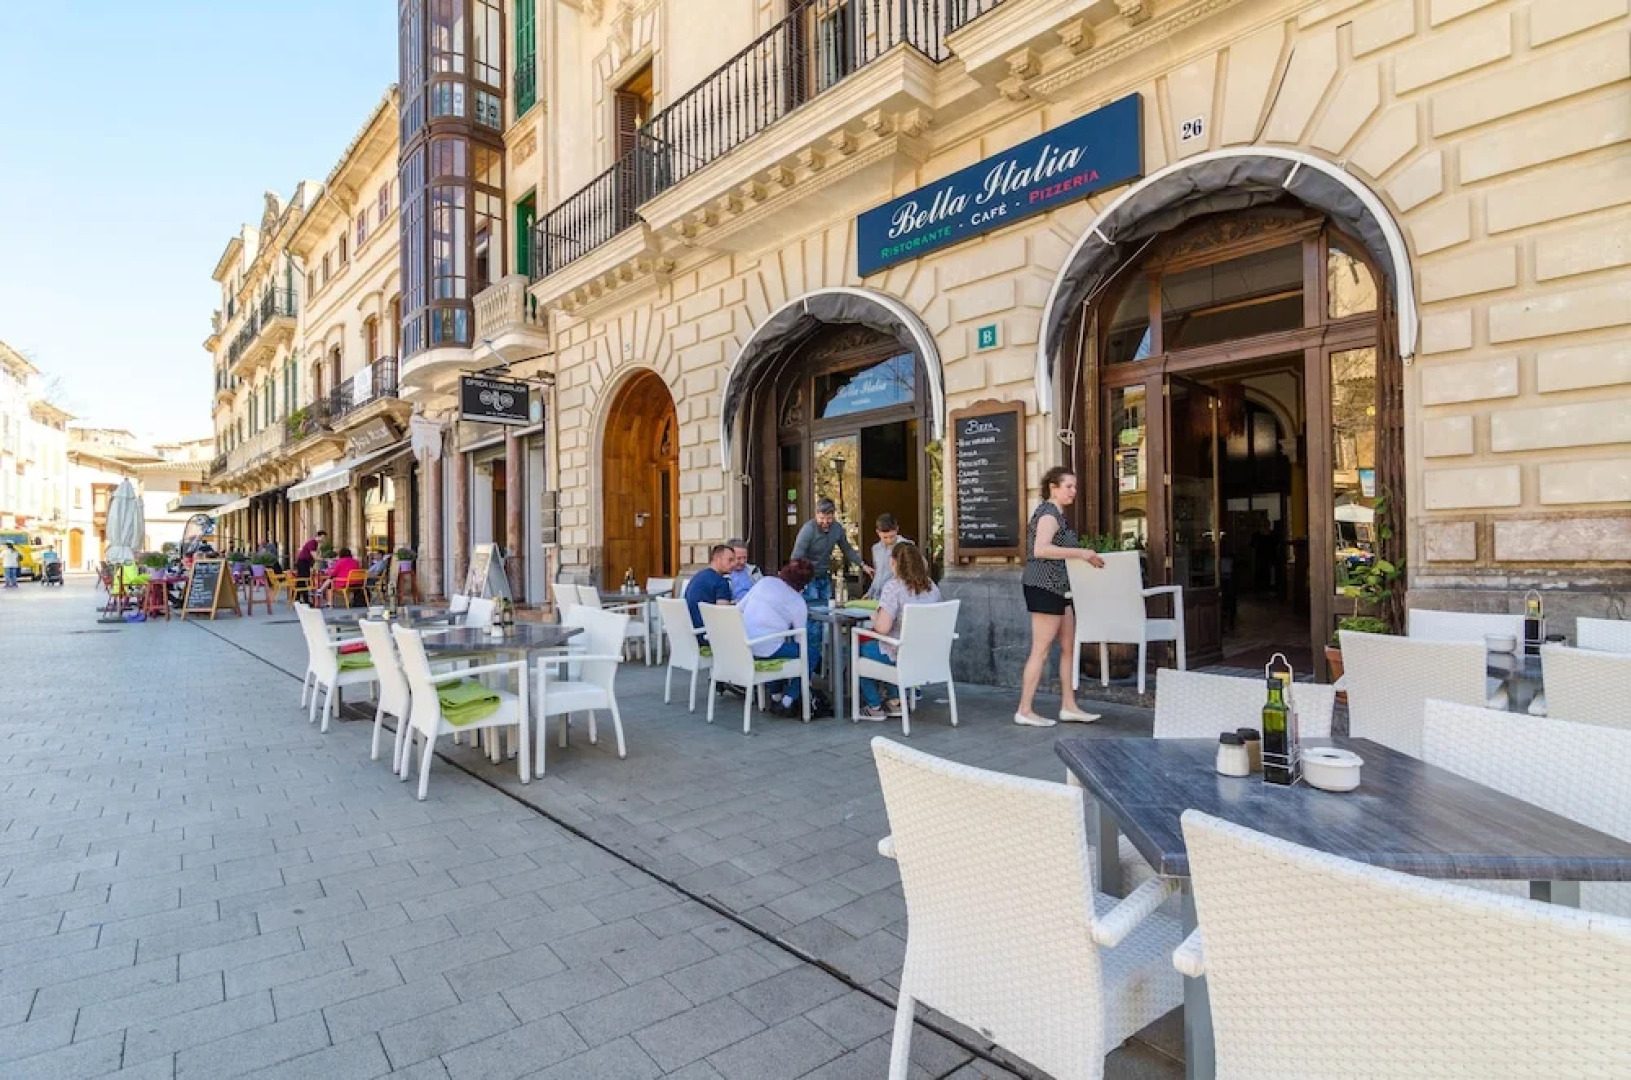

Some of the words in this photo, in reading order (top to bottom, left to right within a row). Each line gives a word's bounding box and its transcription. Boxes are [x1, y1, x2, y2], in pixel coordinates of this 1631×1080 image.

[1182, 118, 1202, 141] 26
[888, 186, 972, 239] Bella
[975, 144, 1088, 205] Italia
